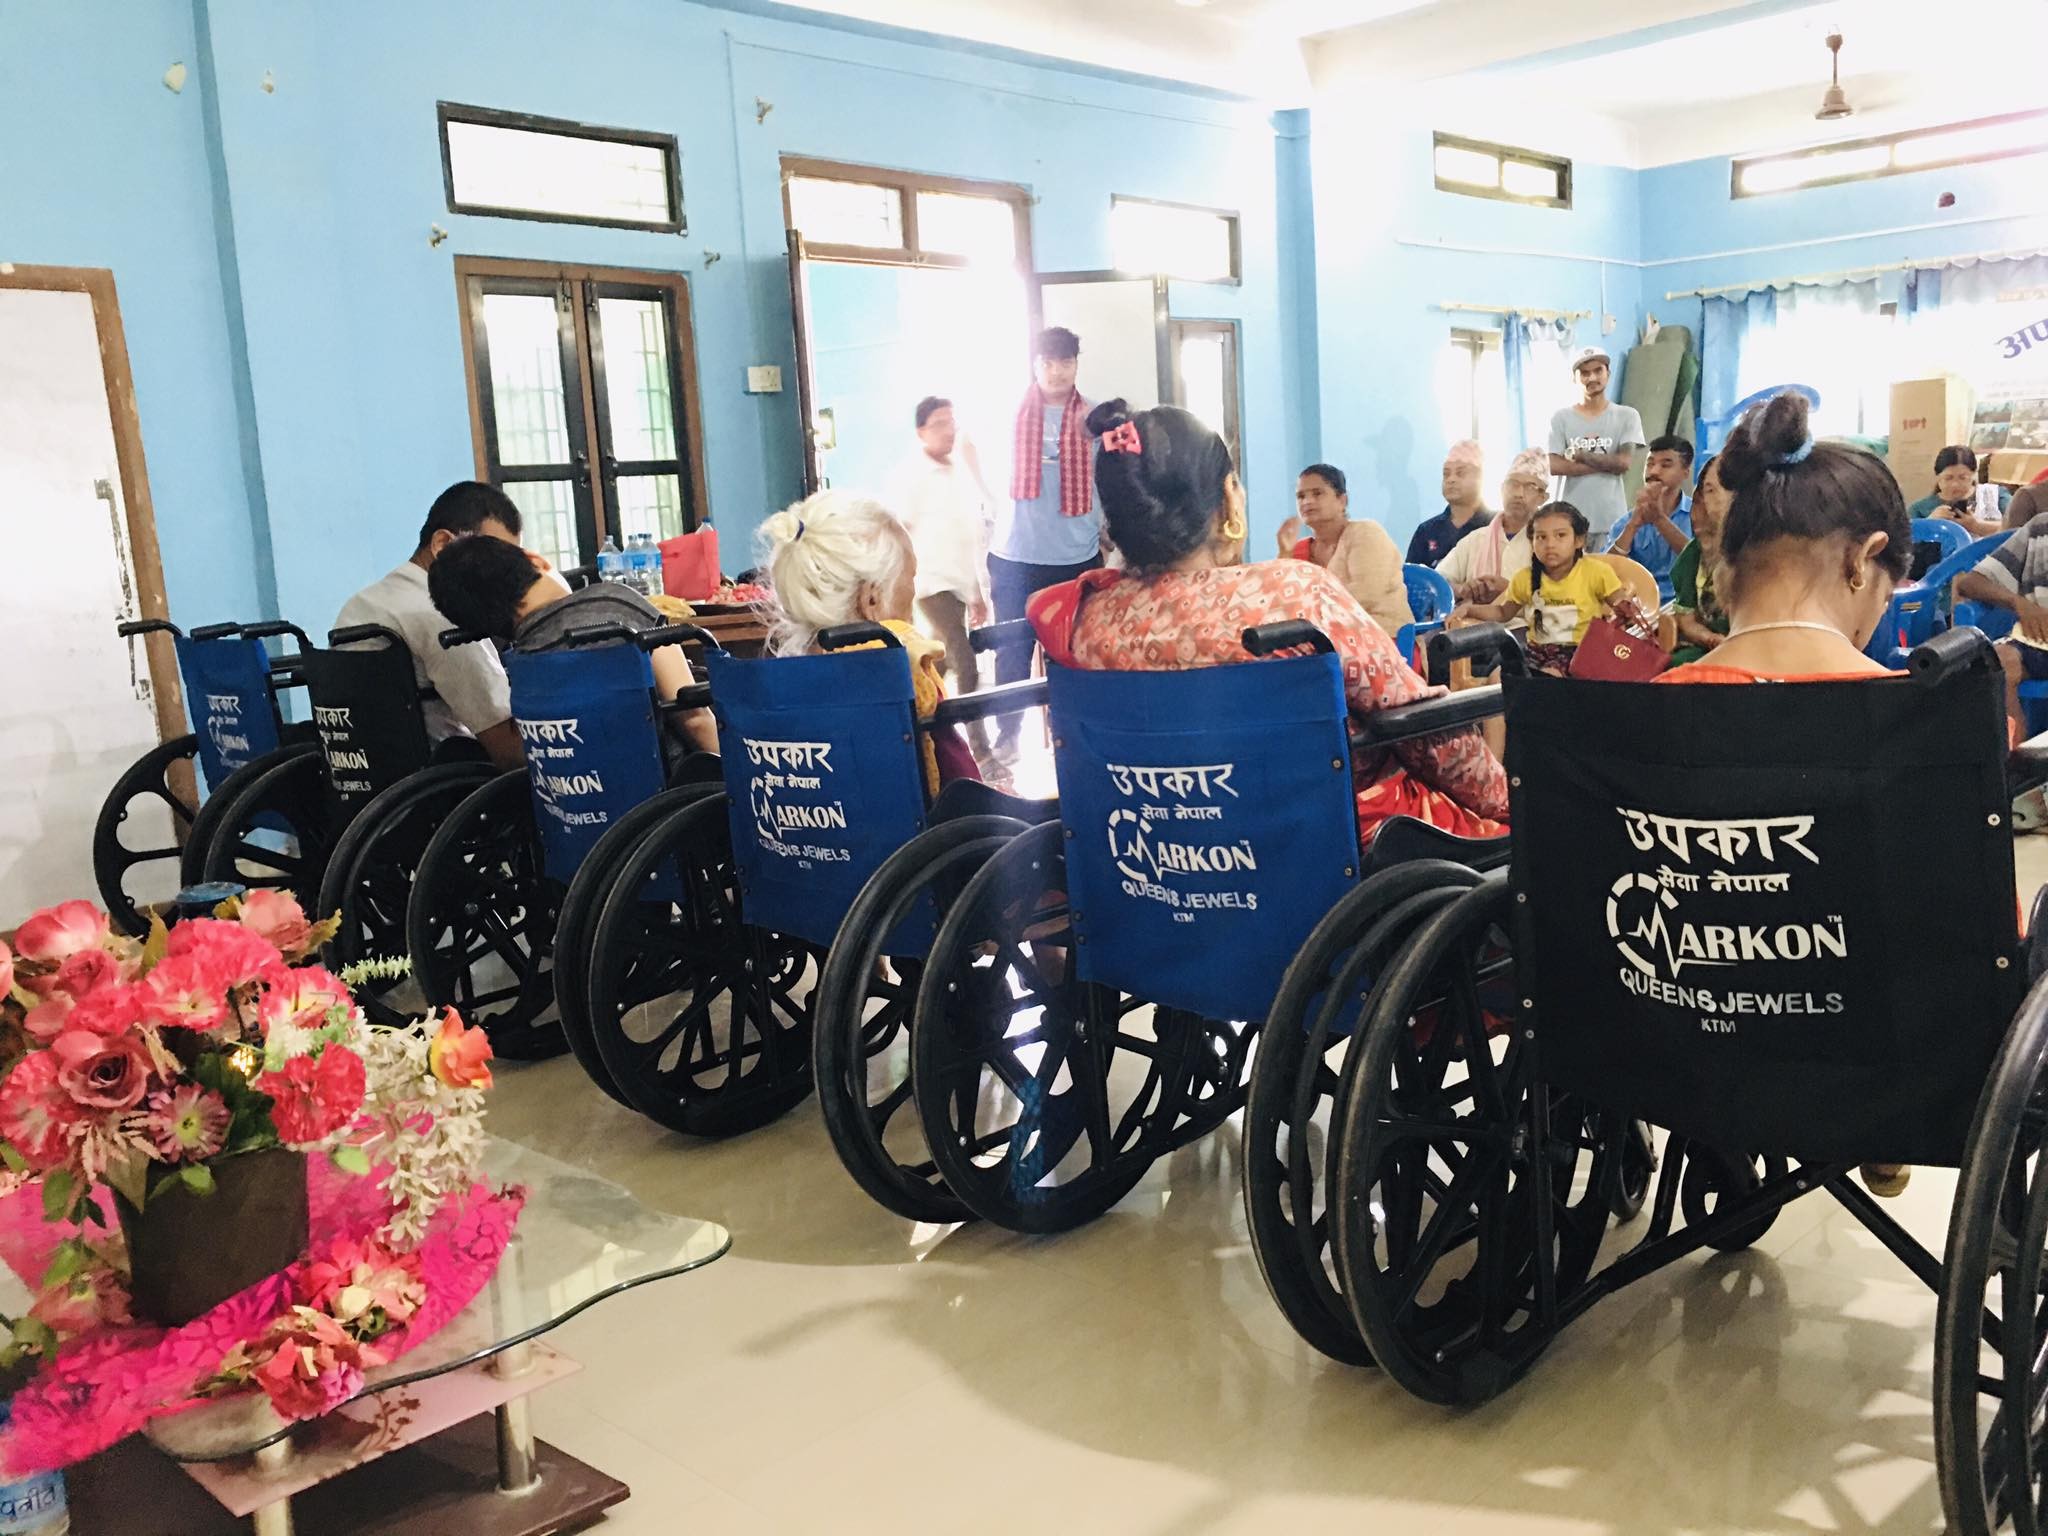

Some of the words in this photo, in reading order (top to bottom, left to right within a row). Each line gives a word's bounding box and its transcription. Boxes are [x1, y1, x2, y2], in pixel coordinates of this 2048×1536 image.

[743, 737, 834, 773] उपकार
[786, 772, 822, 789] नेपाल
[1106, 762, 1240, 799] उपकार
[1140, 803, 1169, 820] सेवा
[1173, 803, 1223, 820] नेपाल
[1615, 806, 1820, 865] उपकार
[801, 844, 851, 862] JEWELS
[1655, 864, 1700, 892] सेवा
[1707, 869, 1791, 894] नेपाल
[1121, 880, 1180, 908] QUEENS
[1182, 891, 1258, 911] JEWELS
[1173, 912, 1195, 923] KTM
[1619, 966, 1718, 1014] QUEENS
[1720, 991, 1845, 1015] JEWELS
[1700, 1018, 1737, 1034] KTM
